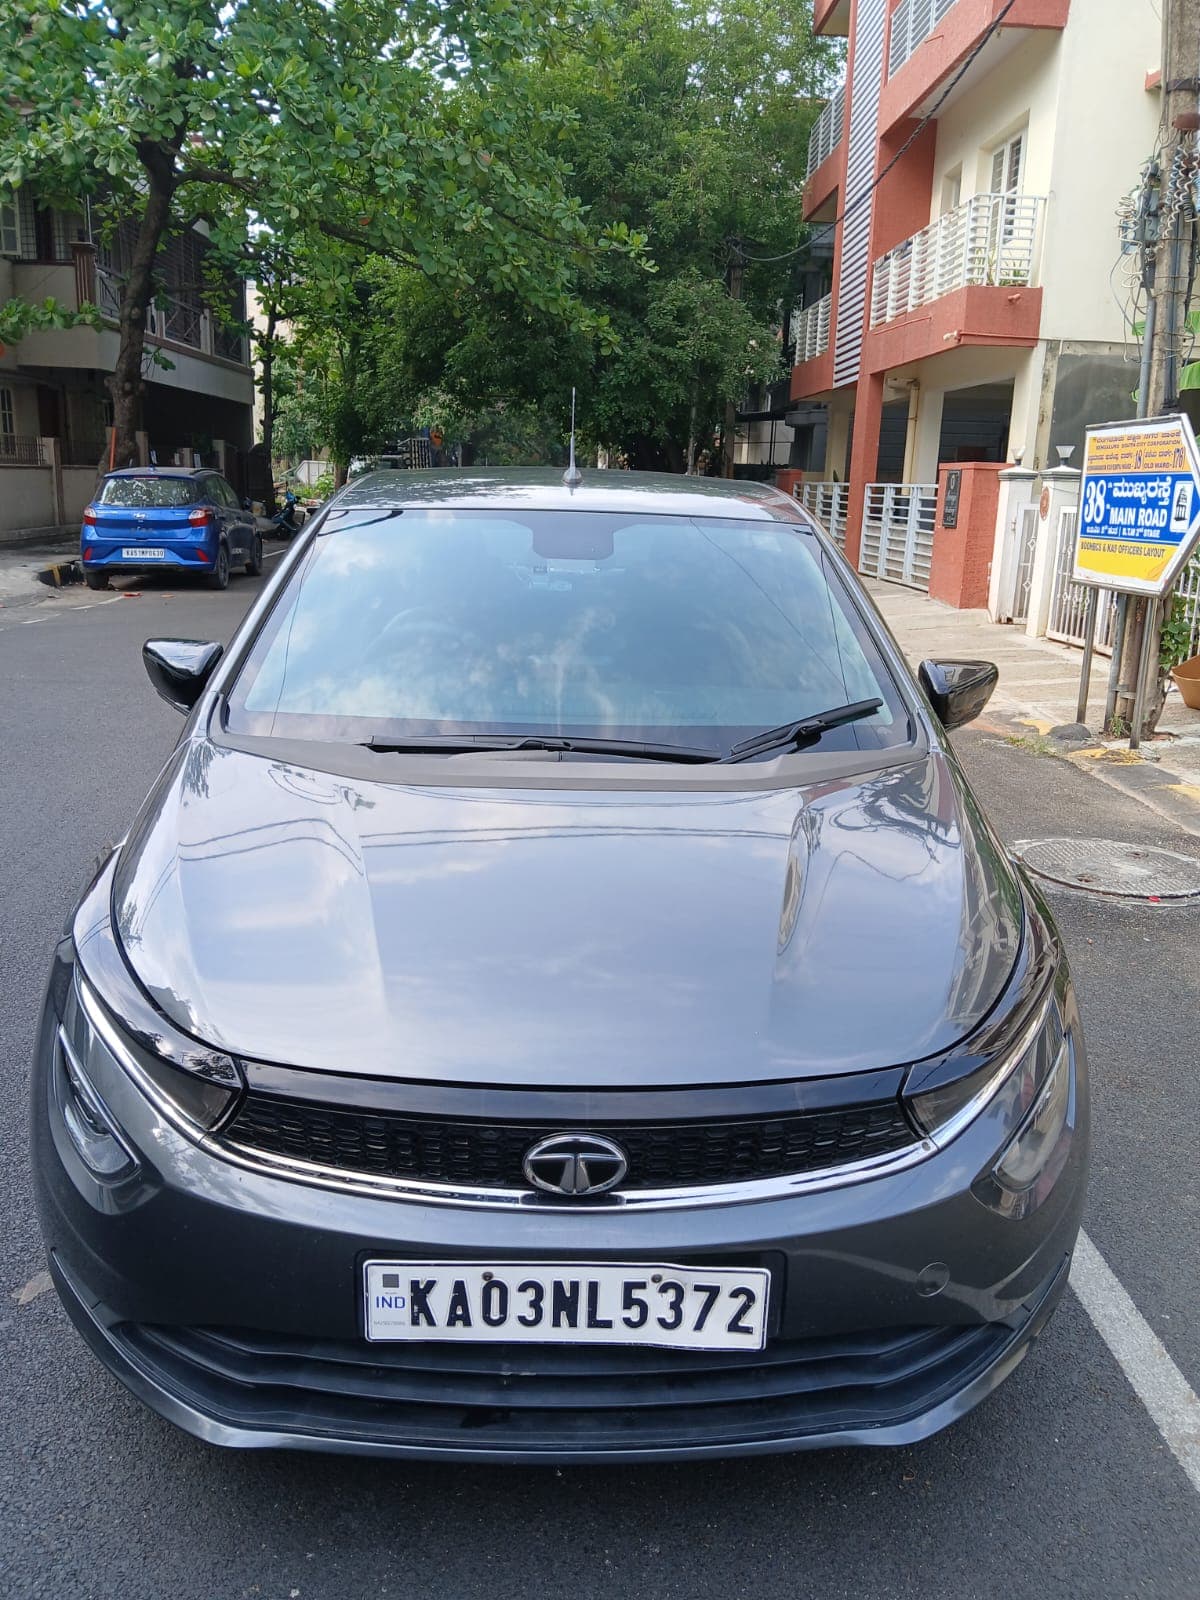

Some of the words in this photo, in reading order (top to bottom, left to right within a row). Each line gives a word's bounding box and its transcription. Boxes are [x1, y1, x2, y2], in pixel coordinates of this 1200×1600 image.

[1084, 480, 1106, 523] 38
[1109, 507, 1136, 525] MAIN
[1138, 508, 1168, 527] ROAD
[1143, 529, 1161, 538] STAGE
[1118, 545, 1143, 556] OFFICERS
[1143, 548, 1166, 558] LAYOUT
[376, 1296, 406, 1309] IND
[410, 1279, 755, 1334] KA03NL5372
